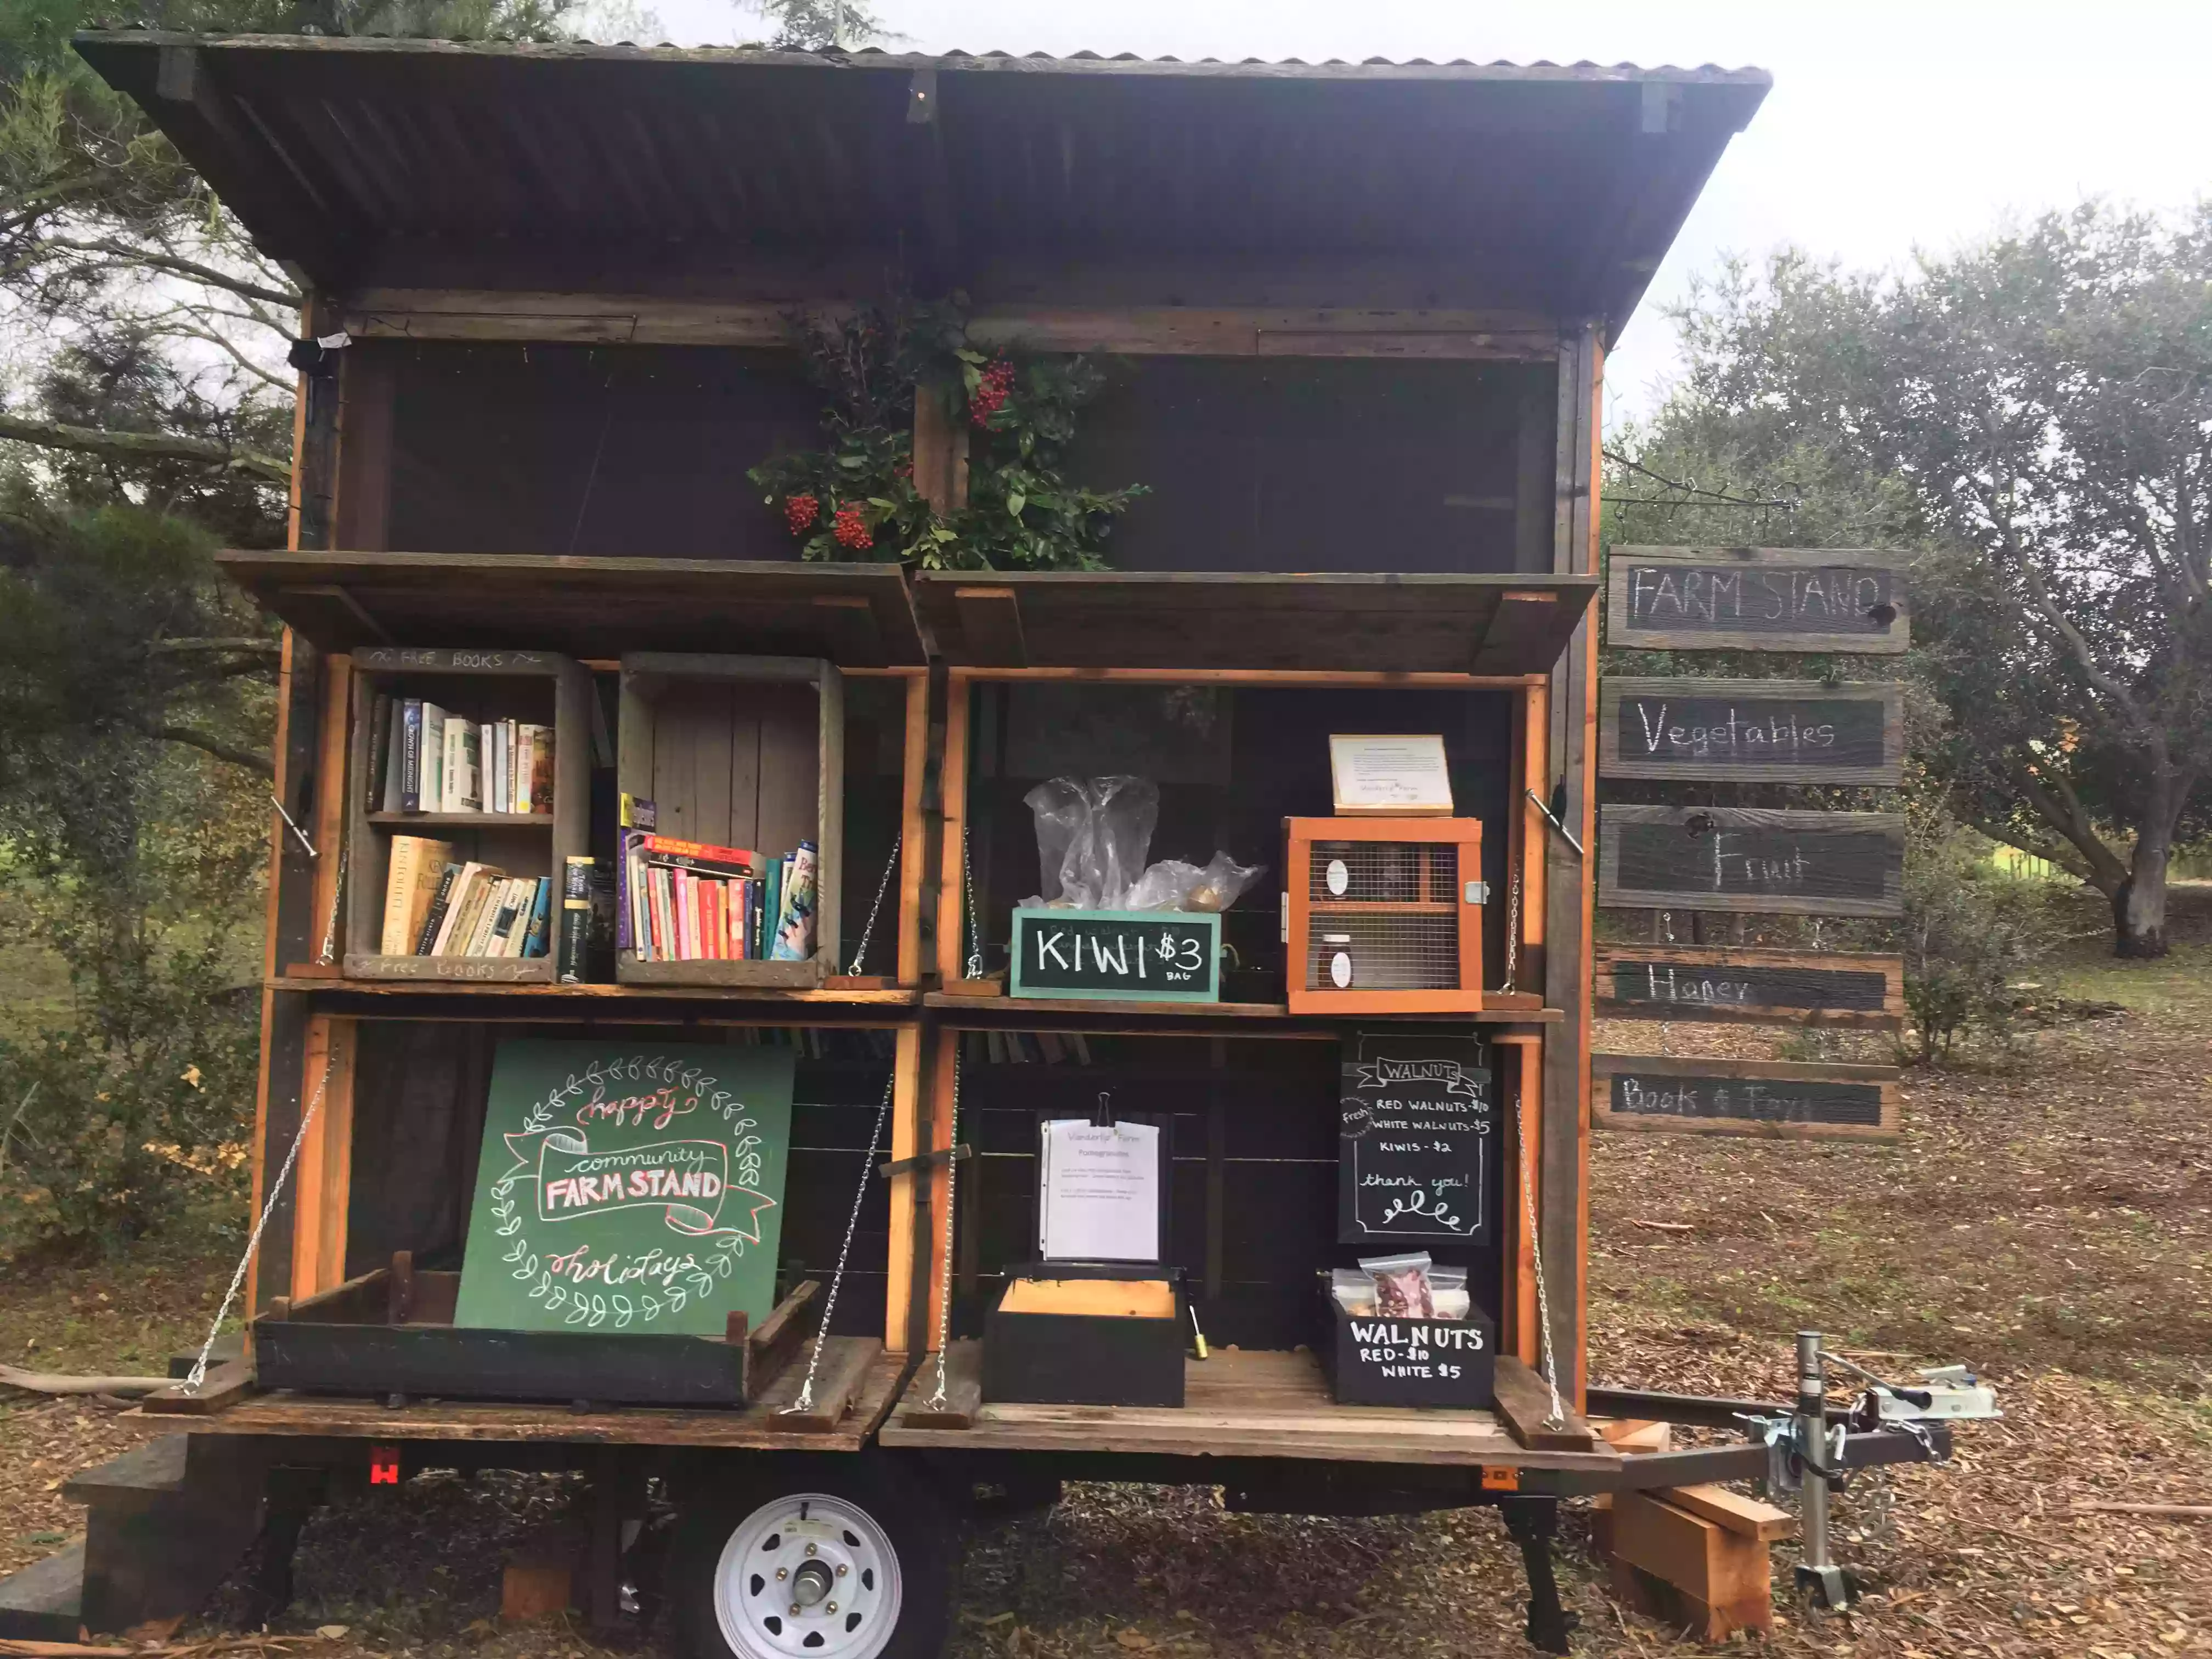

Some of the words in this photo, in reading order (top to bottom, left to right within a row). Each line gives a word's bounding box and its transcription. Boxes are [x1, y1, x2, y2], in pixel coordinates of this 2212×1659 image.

[1633, 568, 1741, 621] FARM
[1763, 571, 1880, 619] STAND
[401, 651, 436, 665] FREE
[452, 651, 504, 668] BOOKS
[1638, 701, 1836, 757] Vegetables
[1713, 832, 1812, 888] Fruit
[1037, 930, 1147, 978] KIWI
[1154, 932, 1203, 970] $3
[1166, 972, 1192, 980] BAG
[1384, 1063, 1459, 1080] WALNUTS
[577, 1086, 698, 1130] happy
[1376, 1099, 1403, 1110] RED
[1372, 1120, 1408, 1129] WHITE
[1379, 1142, 1421, 1152] KIWIS
[1432, 1140, 1452, 1153] $2
[564, 1148, 718, 1173] community
[546, 1173, 624, 1210] FARM
[629, 1169, 721, 1199] STAND
[1359, 1173, 1423, 1187] thank
[1431, 1173, 1469, 1196] you!
[544, 1244, 702, 1286] holidays
[1349, 1321, 1484, 1350] WALNUTS
[1381, 1365, 1433, 1378] WHITE
[1437, 1362, 1462, 1379] $5
